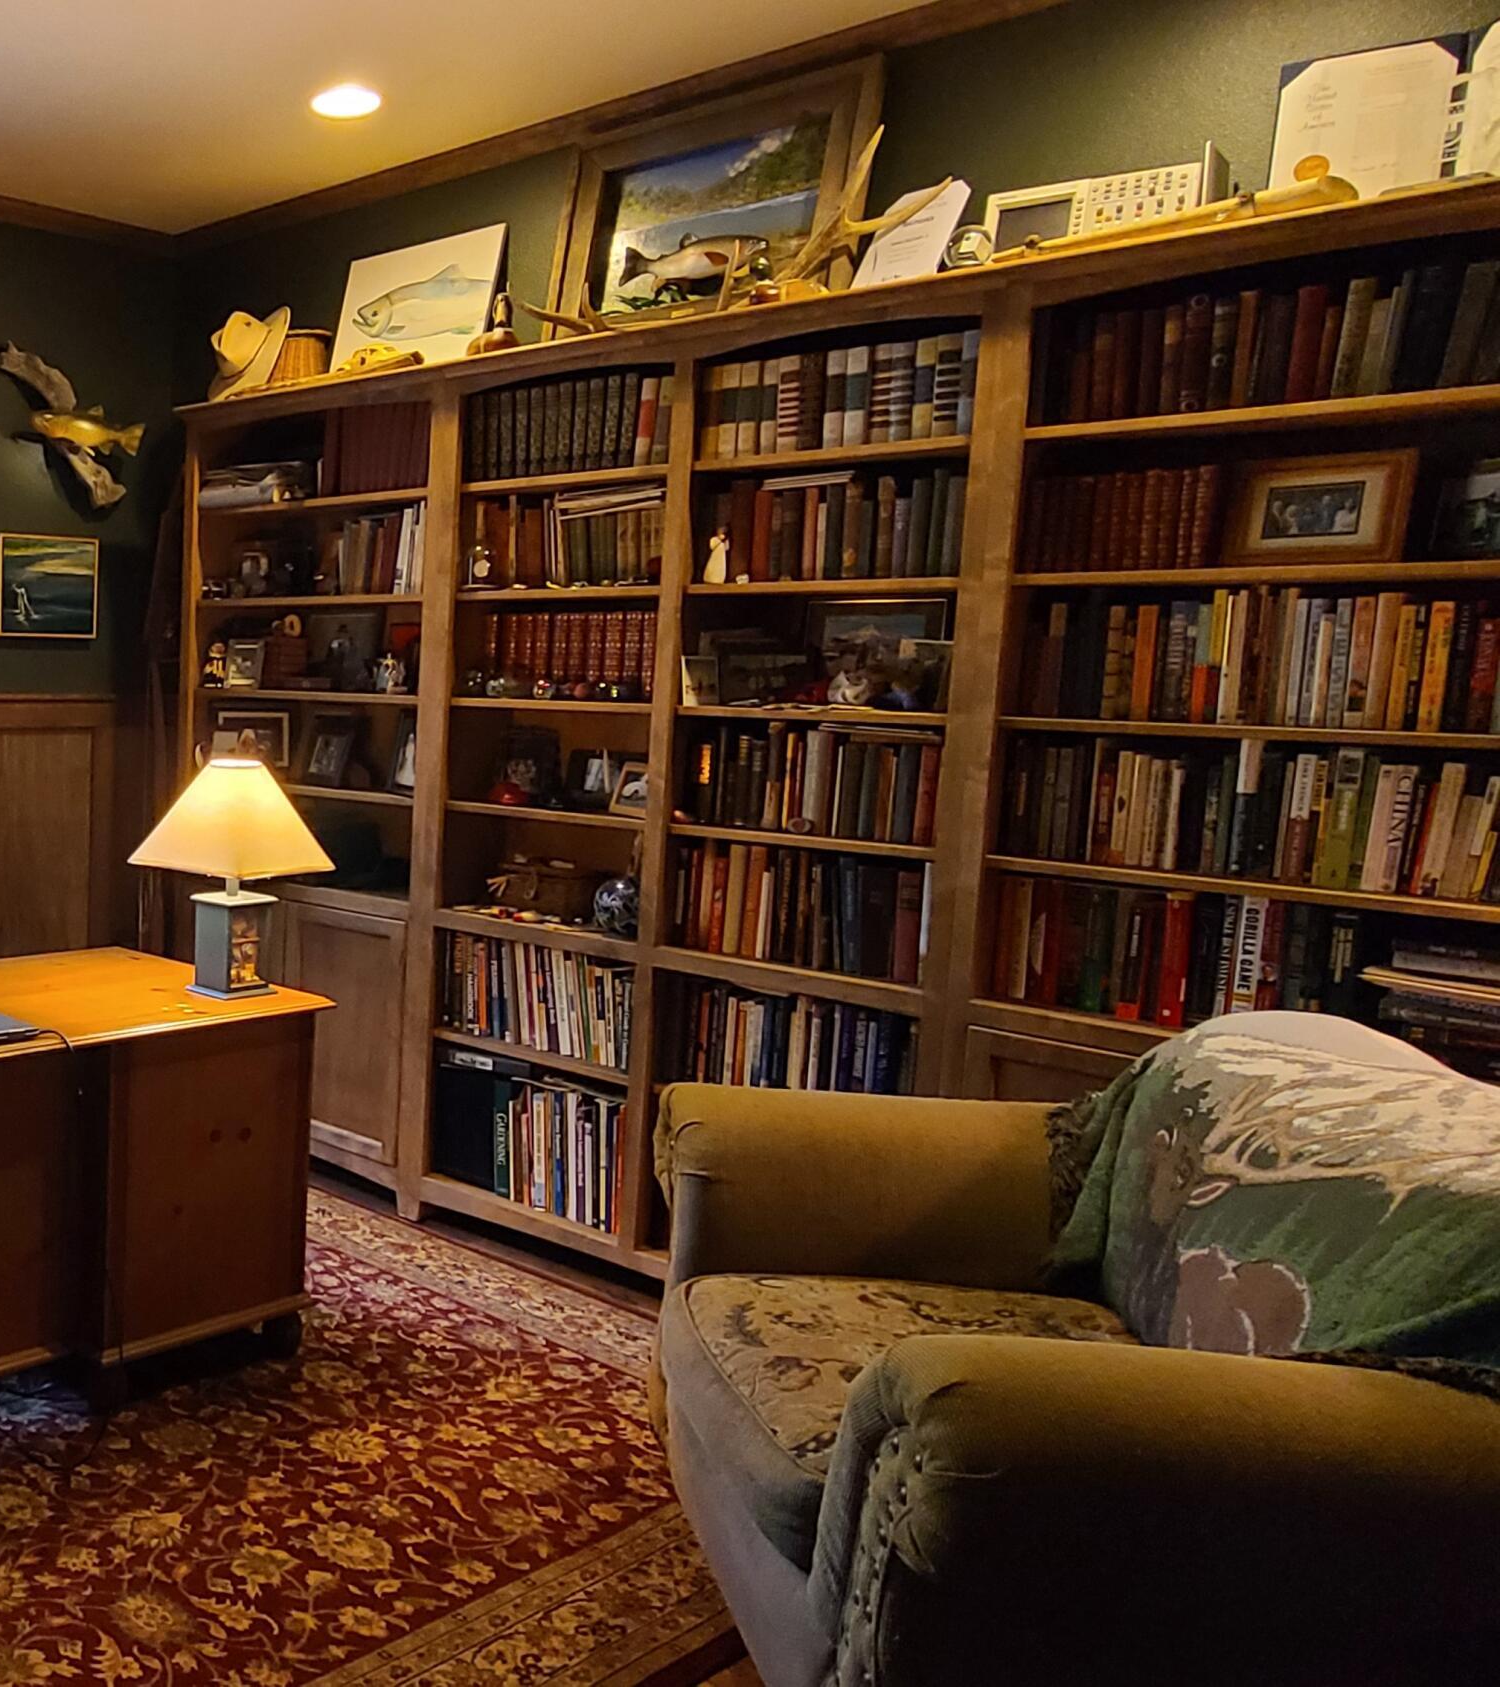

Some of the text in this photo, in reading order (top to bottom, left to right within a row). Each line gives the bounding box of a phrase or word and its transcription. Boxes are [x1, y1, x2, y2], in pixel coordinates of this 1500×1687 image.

[1387, 775, 1412, 844] CHINA
[1237, 907, 1260, 991] GORILLA GAME
